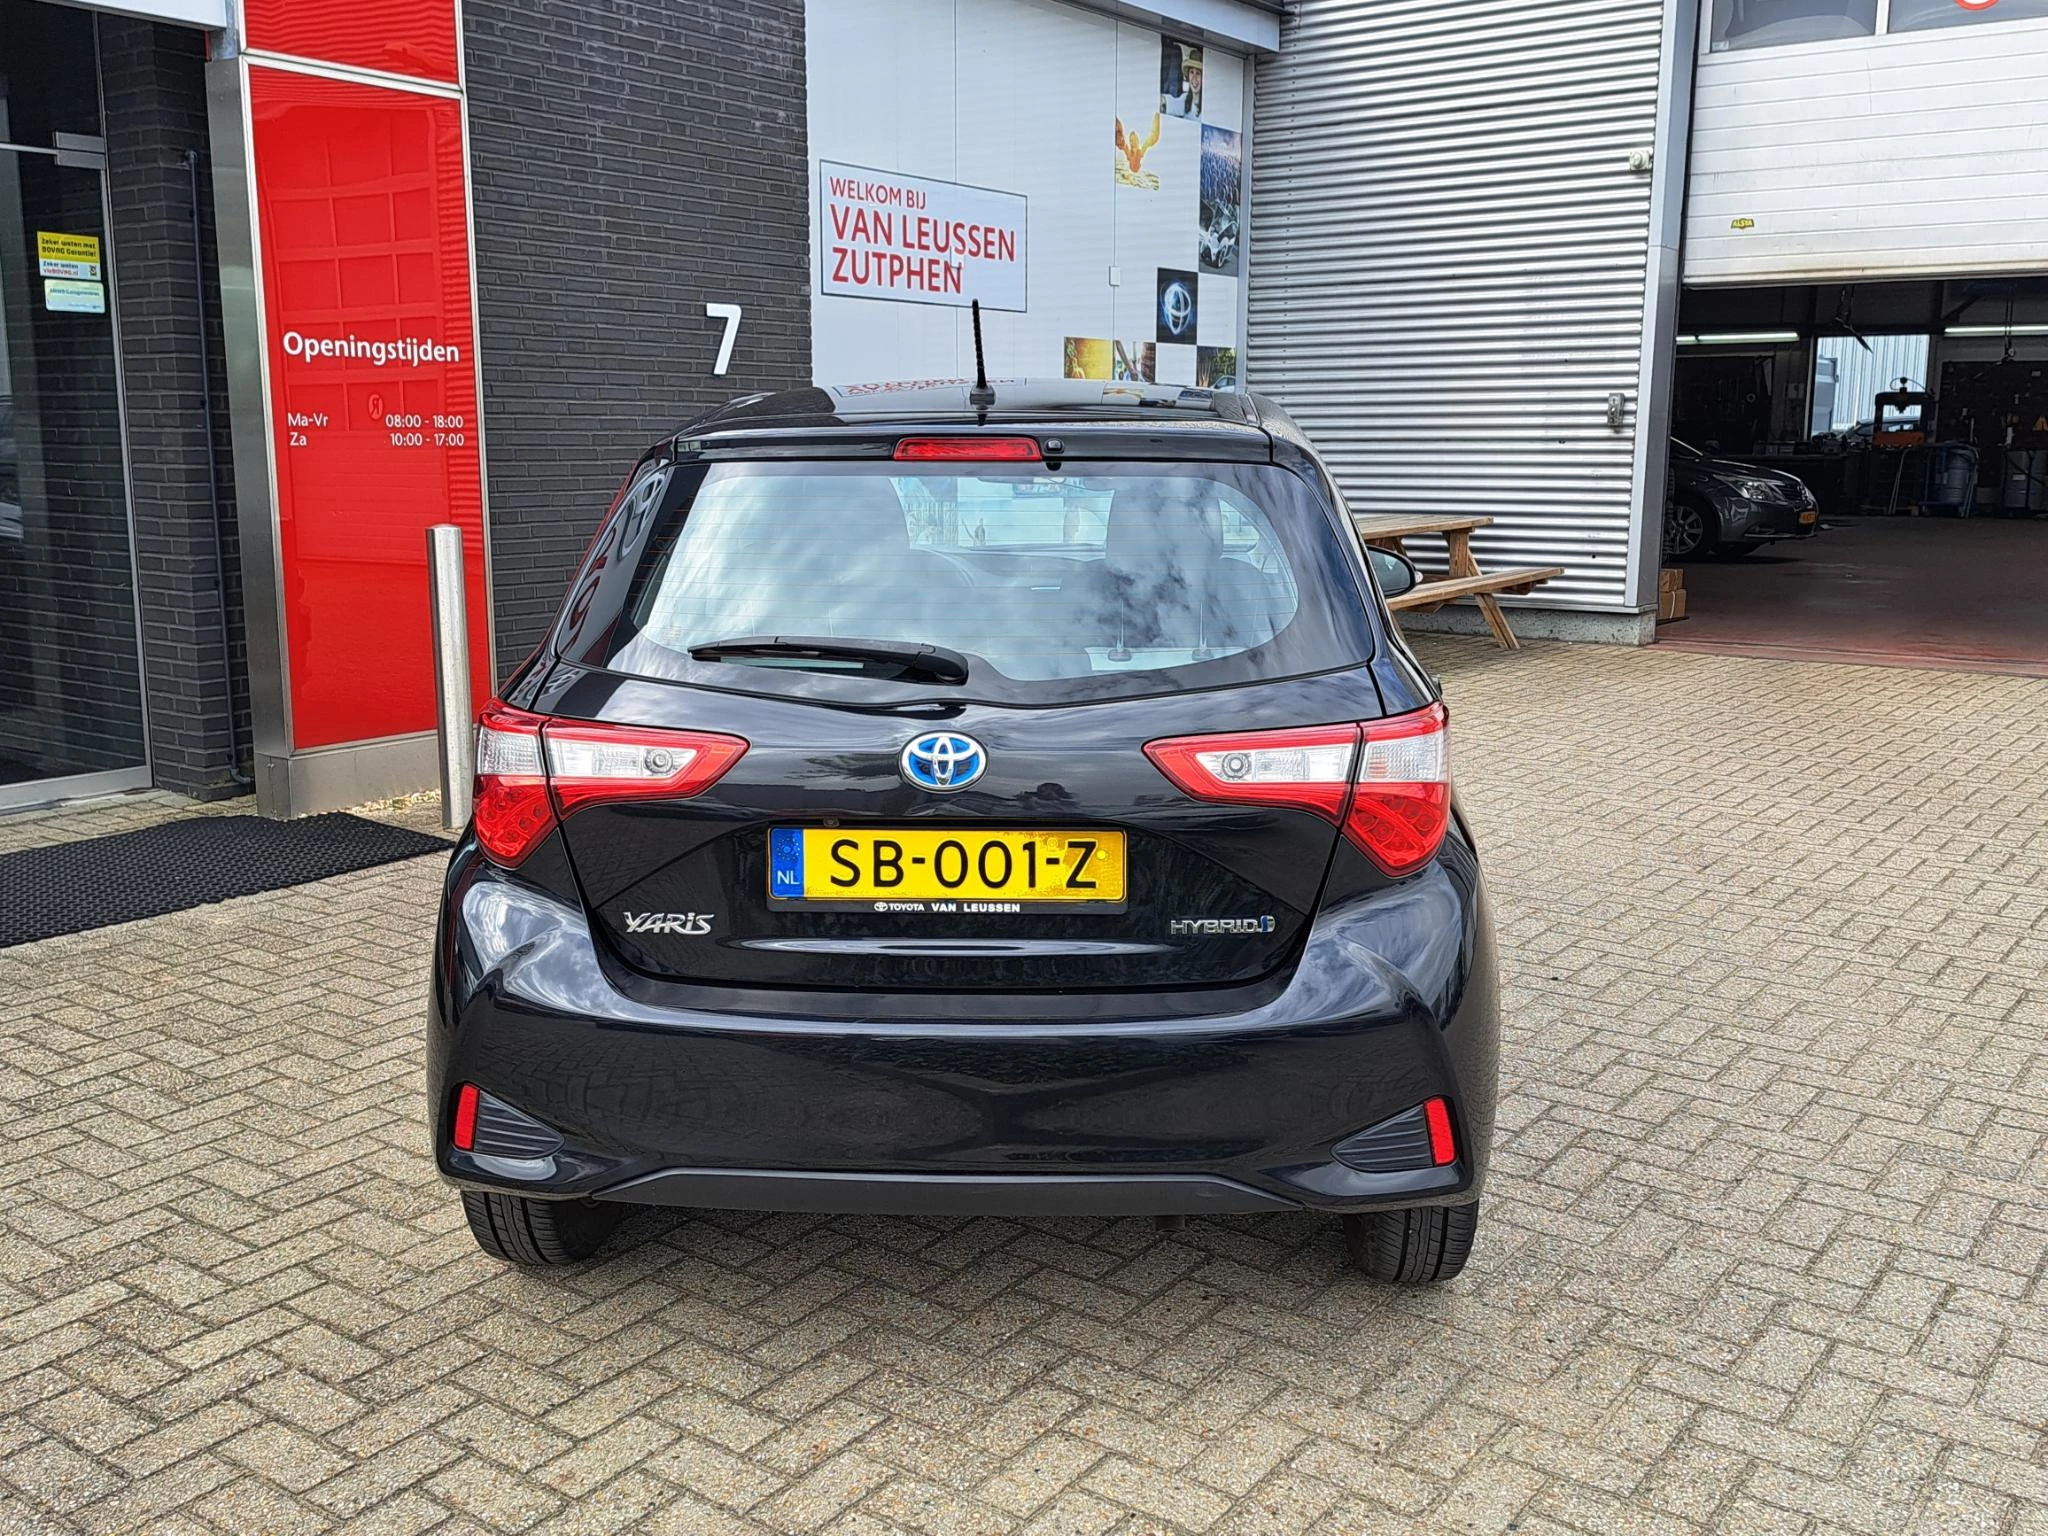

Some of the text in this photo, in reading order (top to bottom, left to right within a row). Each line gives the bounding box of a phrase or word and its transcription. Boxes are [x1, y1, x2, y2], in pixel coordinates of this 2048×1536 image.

[830, 176, 926, 211] WELKOM BIJ
[830, 203, 1015, 262] VAN LEUSSEN
[832, 246, 962, 294] ZUTPHEN
[706, 302, 742, 375] 7
[283, 331, 460, 367] Openingstijden
[287, 412, 329, 427] Ma-Vr
[385, 414, 422, 428] 08:00
[432, 415, 464, 428] 18:00
[289, 432, 308, 446] Za
[389, 433, 423, 446] 10:00
[434, 433, 465, 446] 17:00
[829, 840, 1098, 889] SB-001-Z
[777, 870, 800, 885] NL
[888, 903, 1020, 913] TOYOTA VAN LEUSSEN
[1170, 919, 1259, 935] HYBRID
